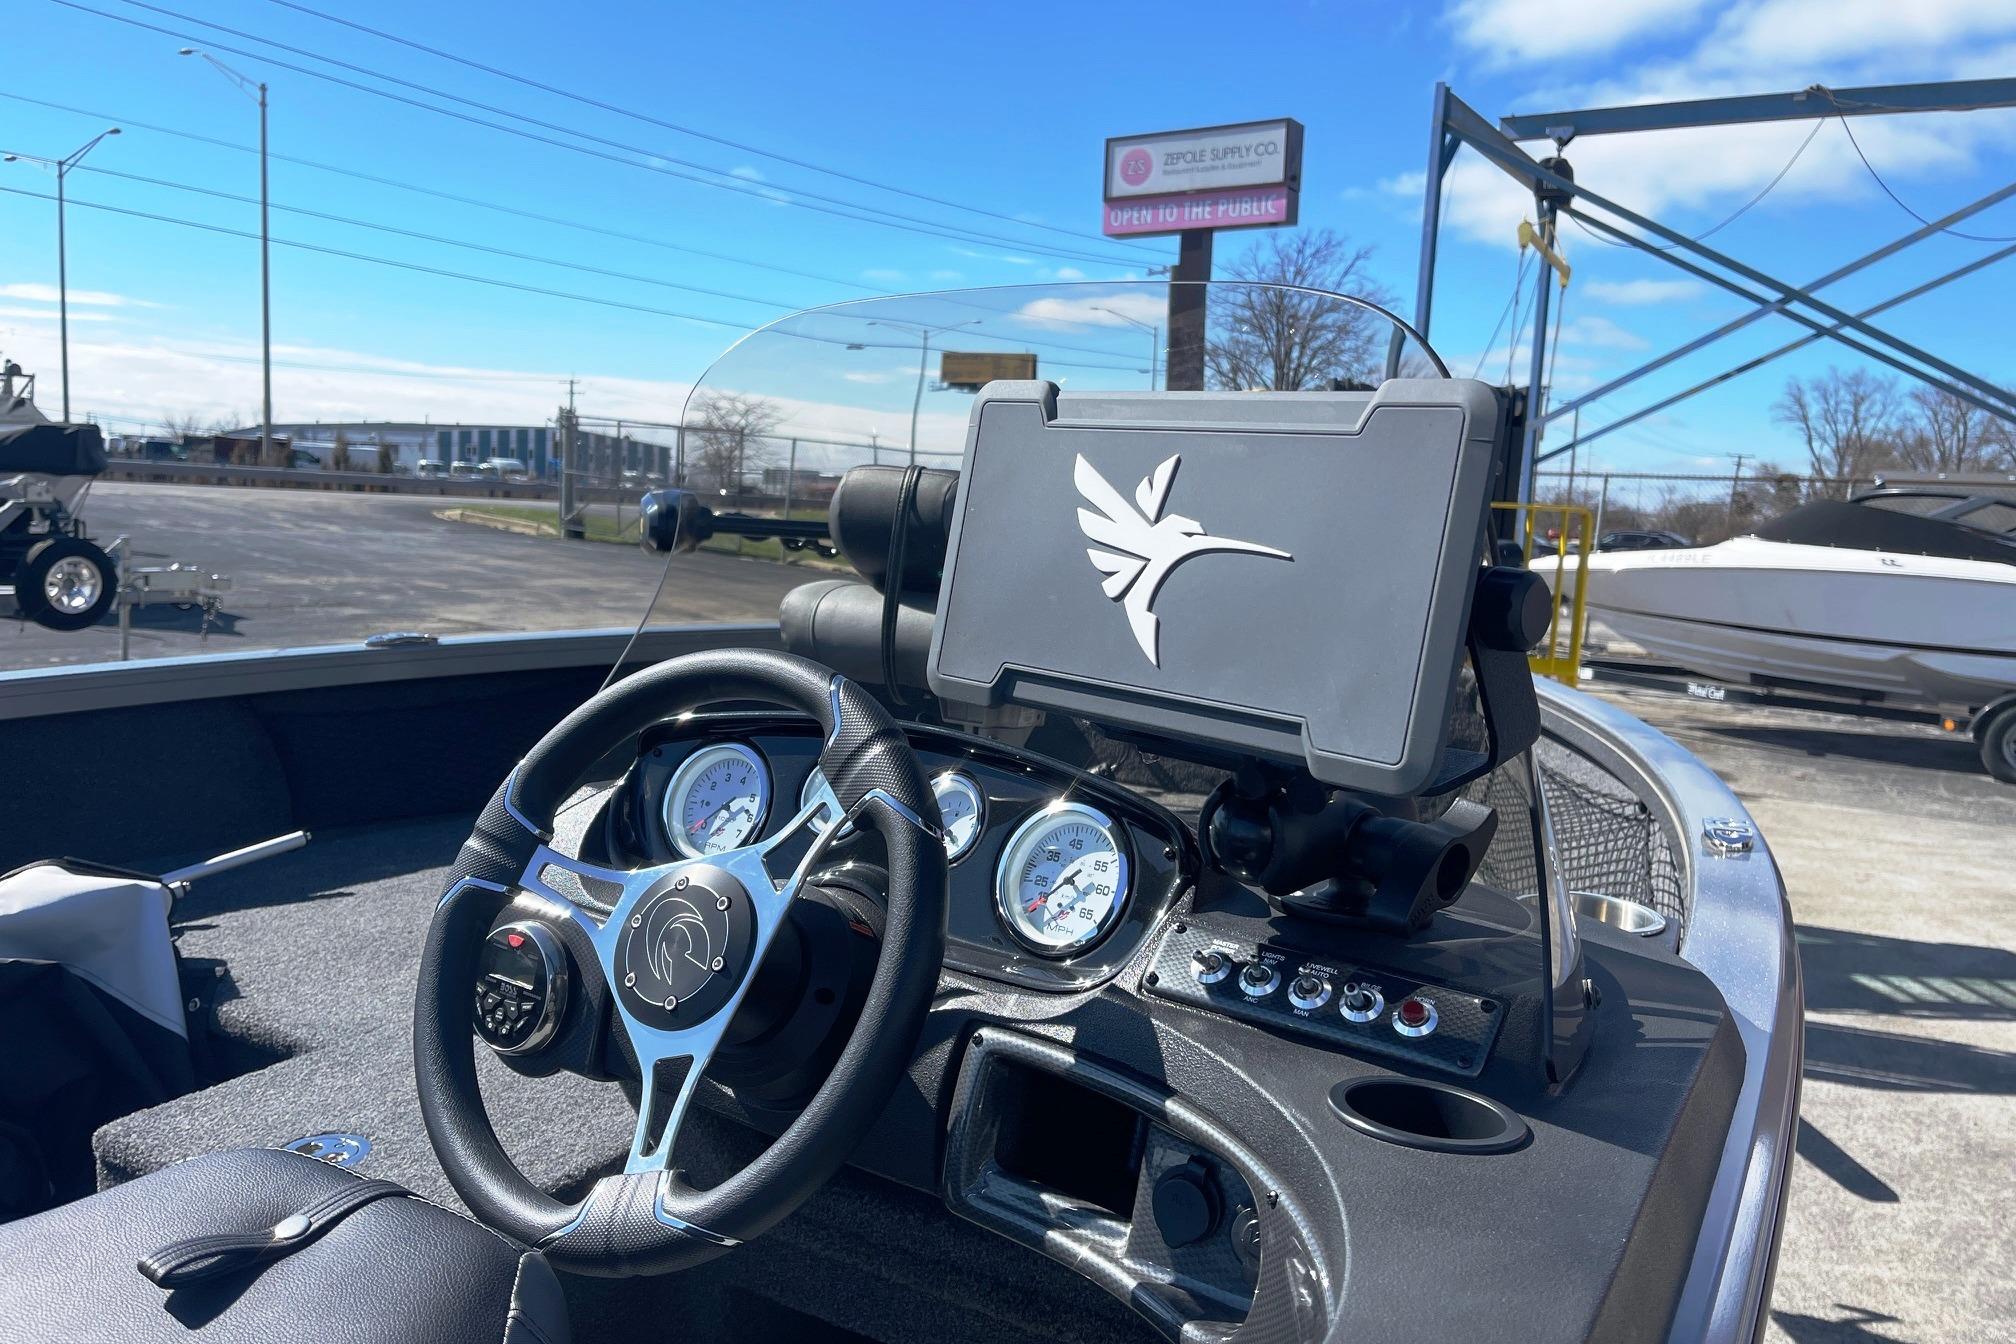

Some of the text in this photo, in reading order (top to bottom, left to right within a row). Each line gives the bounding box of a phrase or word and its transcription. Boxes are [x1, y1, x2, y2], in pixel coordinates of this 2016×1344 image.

[1163, 142, 1280, 166] ZEPOLE SUPPLY CO.
[1110, 195, 1278, 227] OPEN TO THE PUBLIC
[725, 773, 732, 782] 3
[740, 776, 747, 786] 4
[710, 781, 717, 791] 2
[749, 793, 757, 803] 5
[747, 813, 754, 823] 6
[736, 829, 743, 838] 7
[704, 841, 726, 852] RPM
[1069, 838, 1084, 850] 45
[1046, 850, 1061, 863] 35
[1094, 860, 1109, 873] 55
[1034, 875, 1049, 887] 25
[1096, 884, 1111, 896] 60
[1079, 908, 1094, 921] 65
[1046, 923, 1074, 936] MPH
[1213, 939, 1240, 950] MASTER
[1261, 951, 1286, 961] LIGHTS
[1264, 958, 1278, 966] NAV
[1306, 962, 1338, 975] LIVEWELL
[1311, 969, 1330, 979] AUTO
[1243, 996, 1259, 1004] ANC
[1413, 995, 1436, 1005] HORN
[1293, 1008, 1309, 1018] MAN
